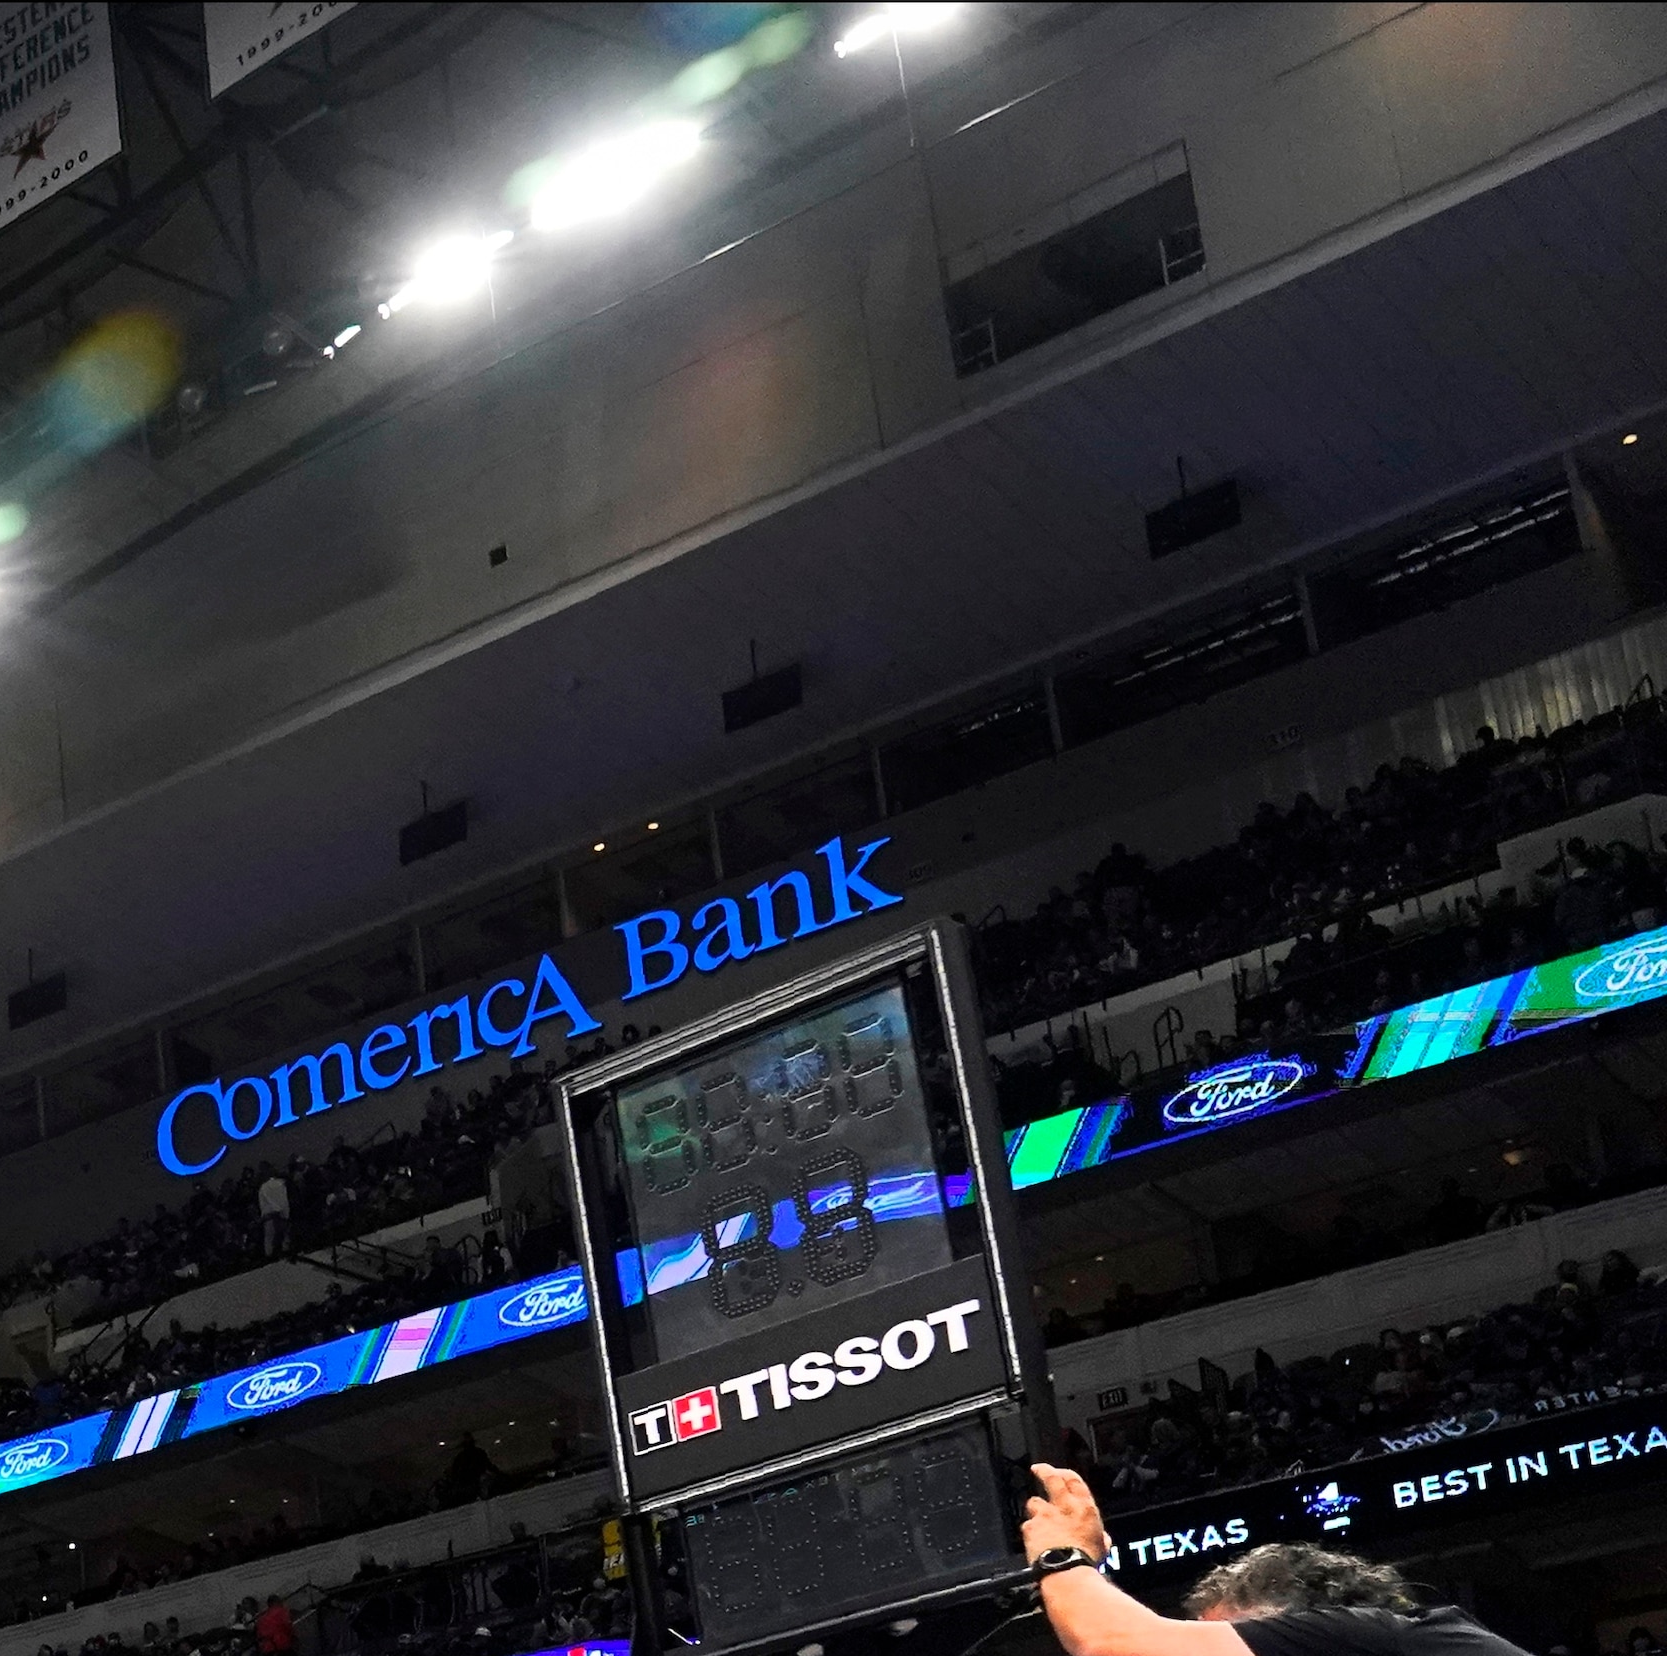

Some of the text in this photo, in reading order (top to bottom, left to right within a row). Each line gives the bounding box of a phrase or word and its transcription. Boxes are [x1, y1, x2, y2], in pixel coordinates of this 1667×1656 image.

[614, 837, 904, 1000] Bank
[1189, 1071, 1274, 1118] Ford
[519, 1283, 586, 1323] Ford
[720, 1301, 981, 1421] TISSOT
[245, 1369, 306, 1405] Ford
[1, 1446, 53, 1479] Ford
[1392, 1426, 1667, 1509] BEST IN TEXA
[1129, 1518, 1249, 1566] TEXAS
